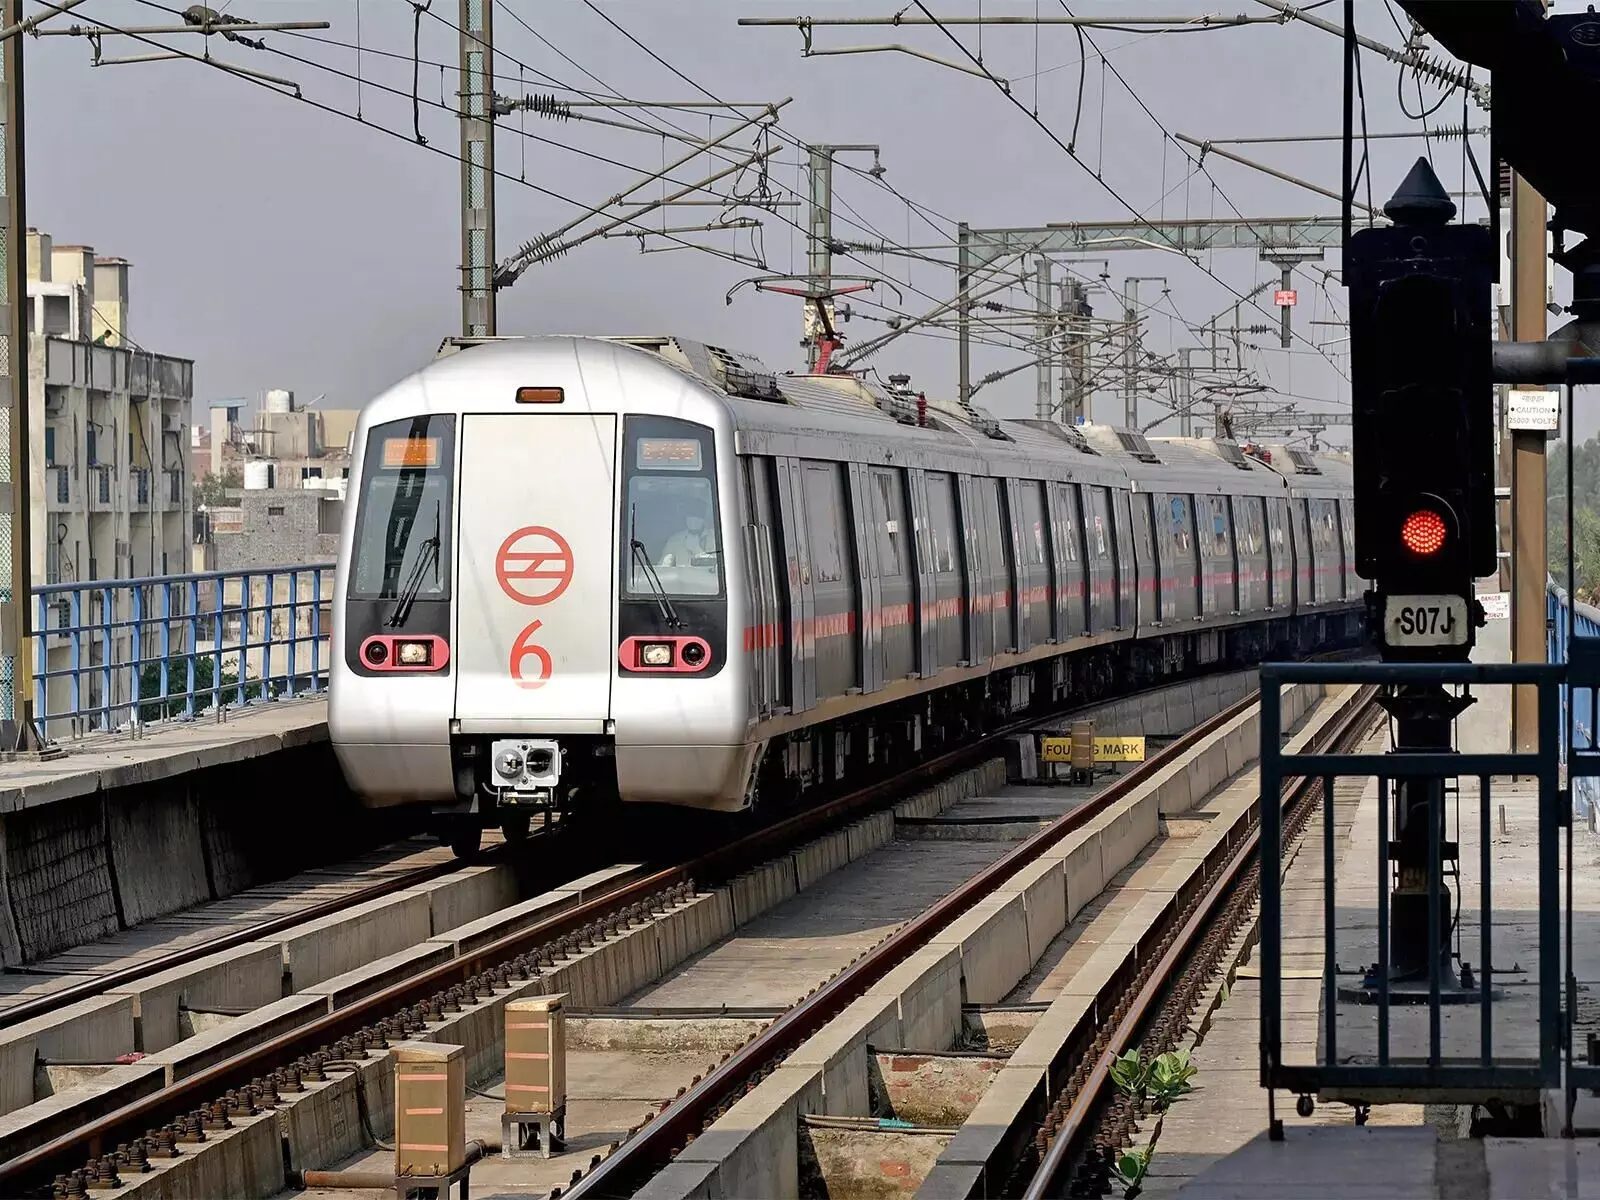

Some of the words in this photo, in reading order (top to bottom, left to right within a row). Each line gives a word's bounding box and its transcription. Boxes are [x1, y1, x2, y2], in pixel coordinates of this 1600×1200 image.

[1516, 406, 1551, 414] CAUTION
[509, 619, 553, 690] 6
[1046, 744, 1099, 755] FOUG
[1103, 743, 1139, 755] MARK
